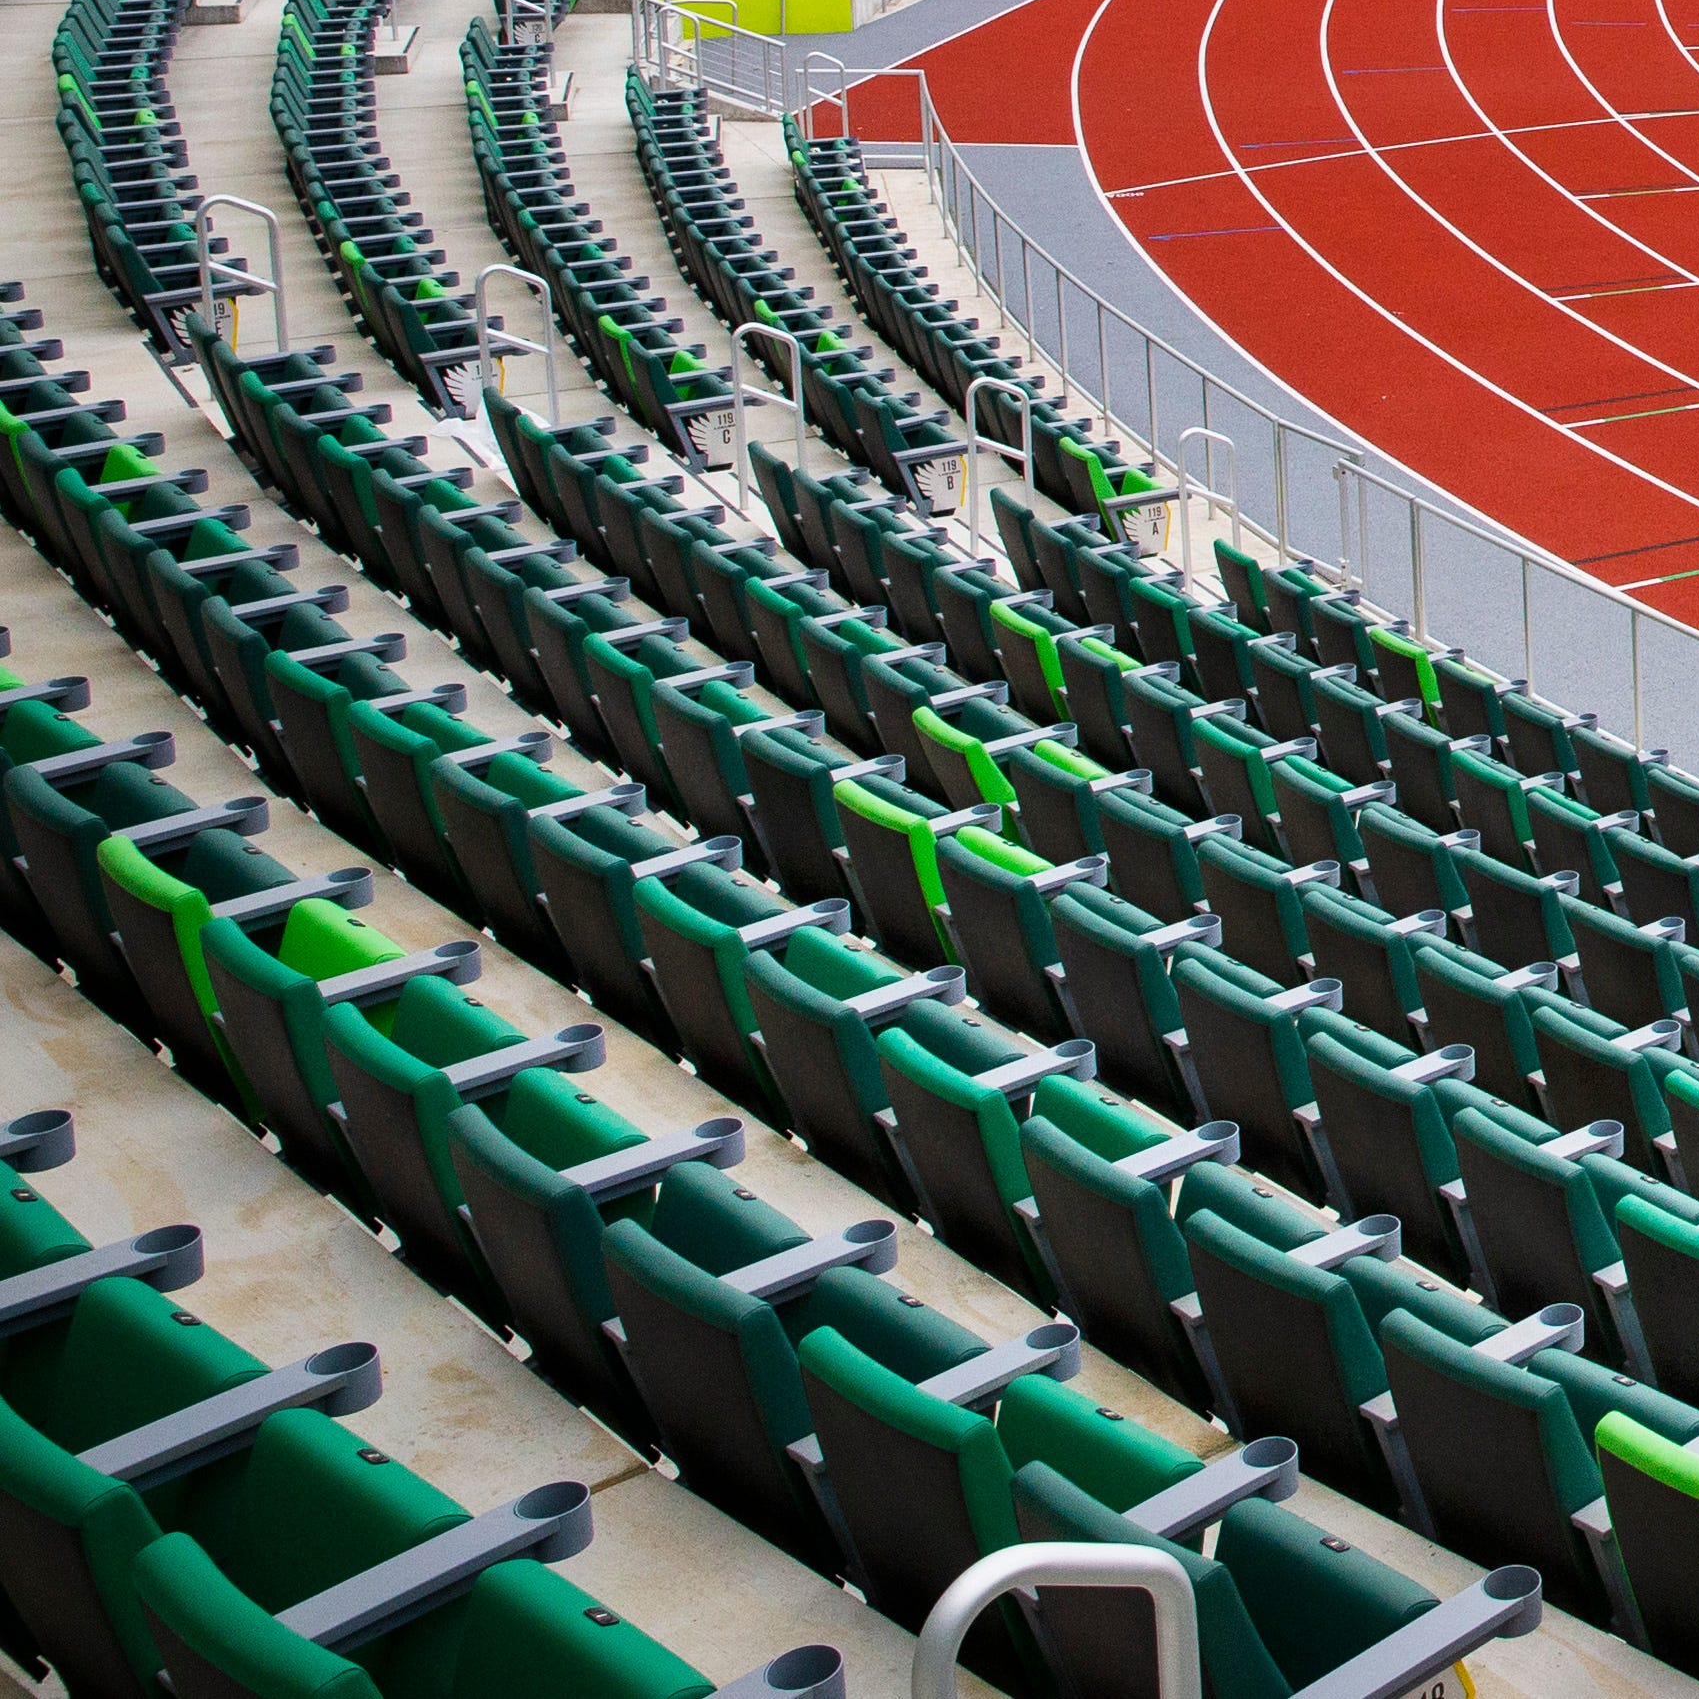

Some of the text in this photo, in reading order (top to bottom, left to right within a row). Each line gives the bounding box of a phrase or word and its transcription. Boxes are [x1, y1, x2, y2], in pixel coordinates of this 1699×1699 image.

[717, 412, 734, 426] 119
[722, 429, 731, 444] C
[1147, 506, 1162, 518] 119
[1152, 521, 1159, 536] A
